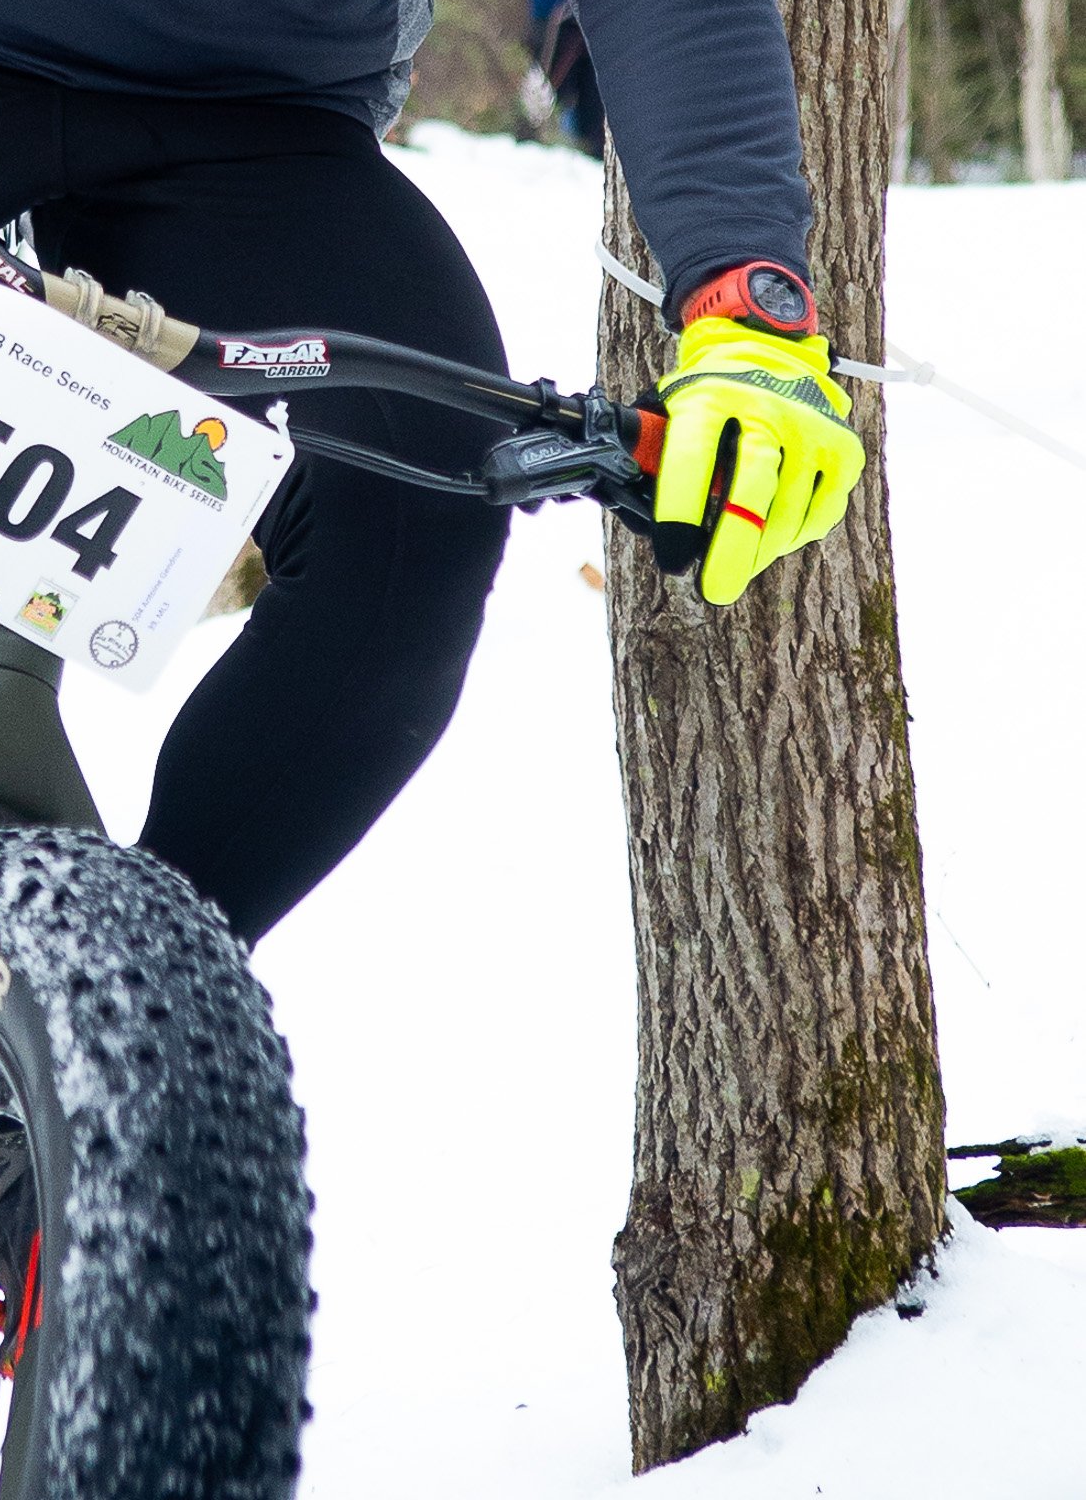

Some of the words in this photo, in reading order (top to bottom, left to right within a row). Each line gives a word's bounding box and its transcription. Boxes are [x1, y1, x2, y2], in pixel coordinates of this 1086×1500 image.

[219, 339, 327, 364] FATBAR
[266, 365, 328, 377] CARBON
[9, 342, 53, 378] Race
[57, 371, 112, 411] Series
[101, 440, 162, 479] MOUNTAIN
[162, 474, 187, 494] BIKE
[189, 489, 225, 513] SERIES
